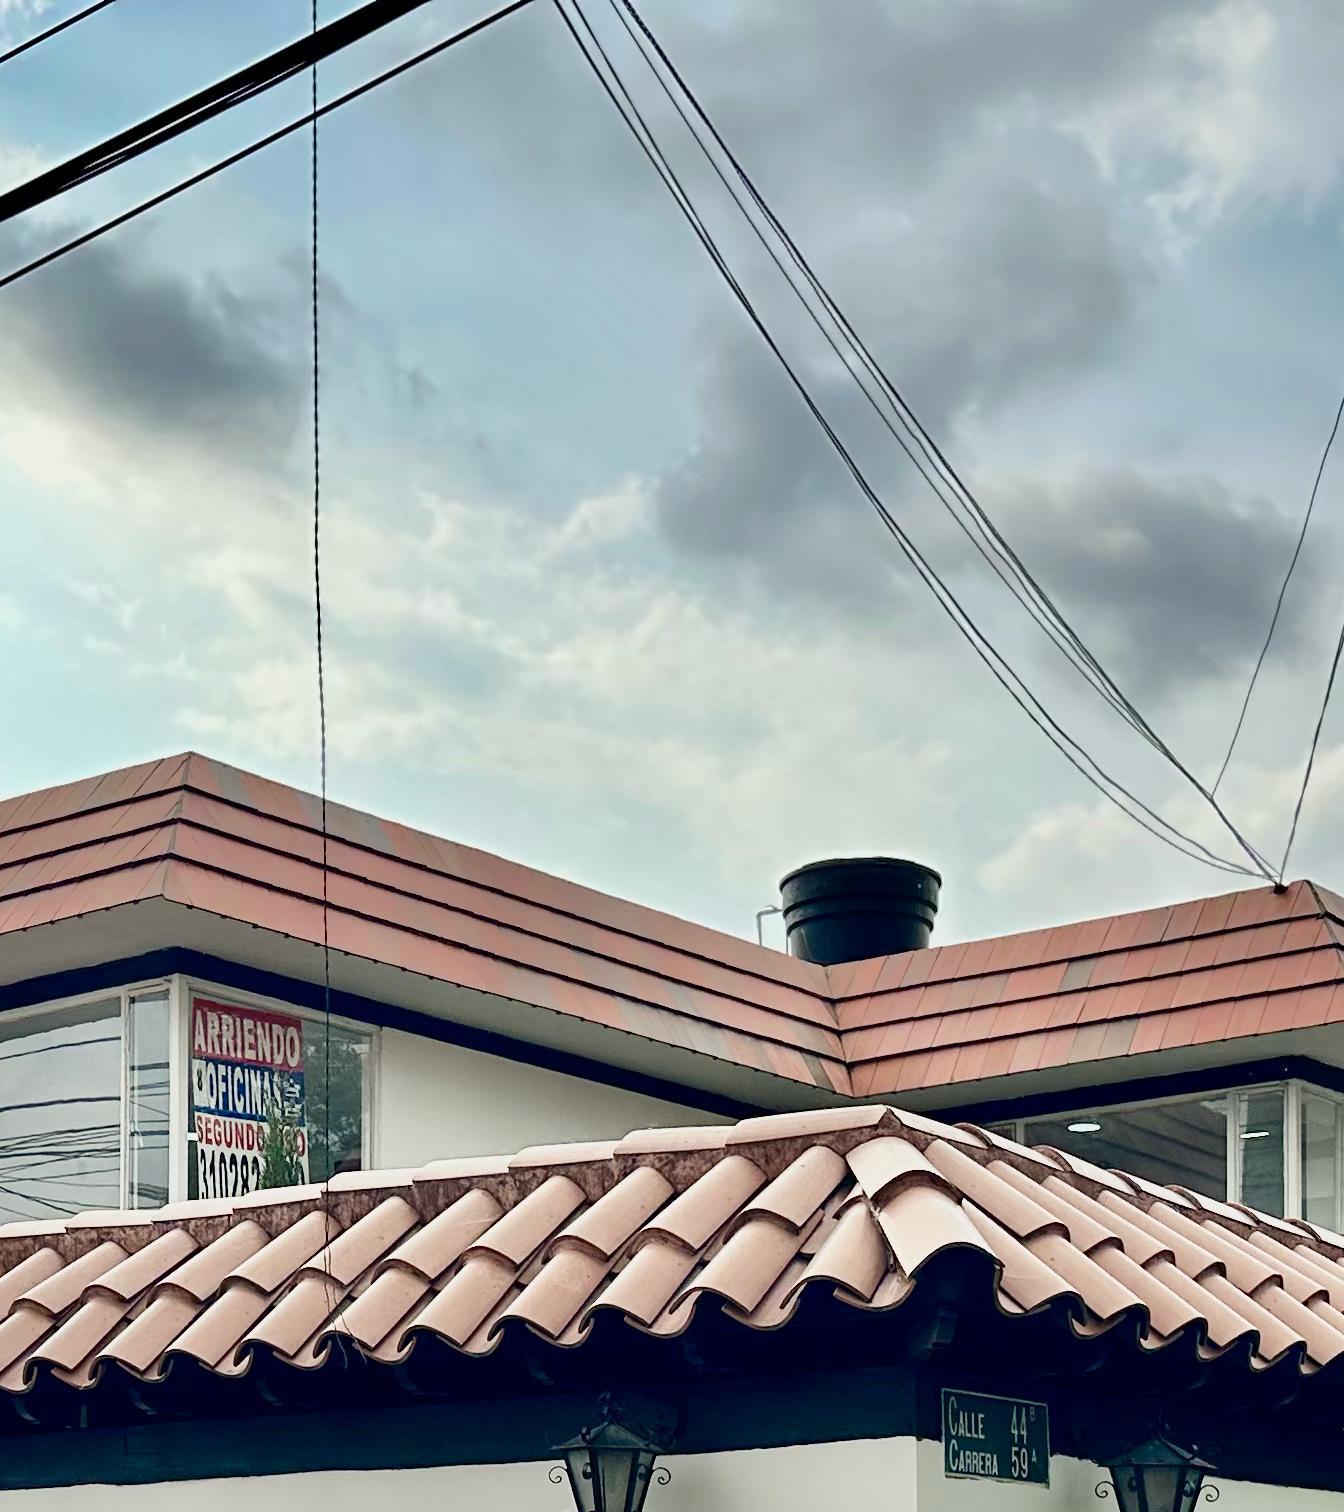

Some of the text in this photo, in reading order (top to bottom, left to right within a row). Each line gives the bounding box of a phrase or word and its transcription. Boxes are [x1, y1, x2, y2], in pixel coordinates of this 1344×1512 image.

[194, 1009, 301, 1067] ARRIENDO
[196, 1115, 265, 1152] SEGUNDO
[948, 1396, 986, 1439] CALLE
[949, 1439, 999, 1476] CARRERA
